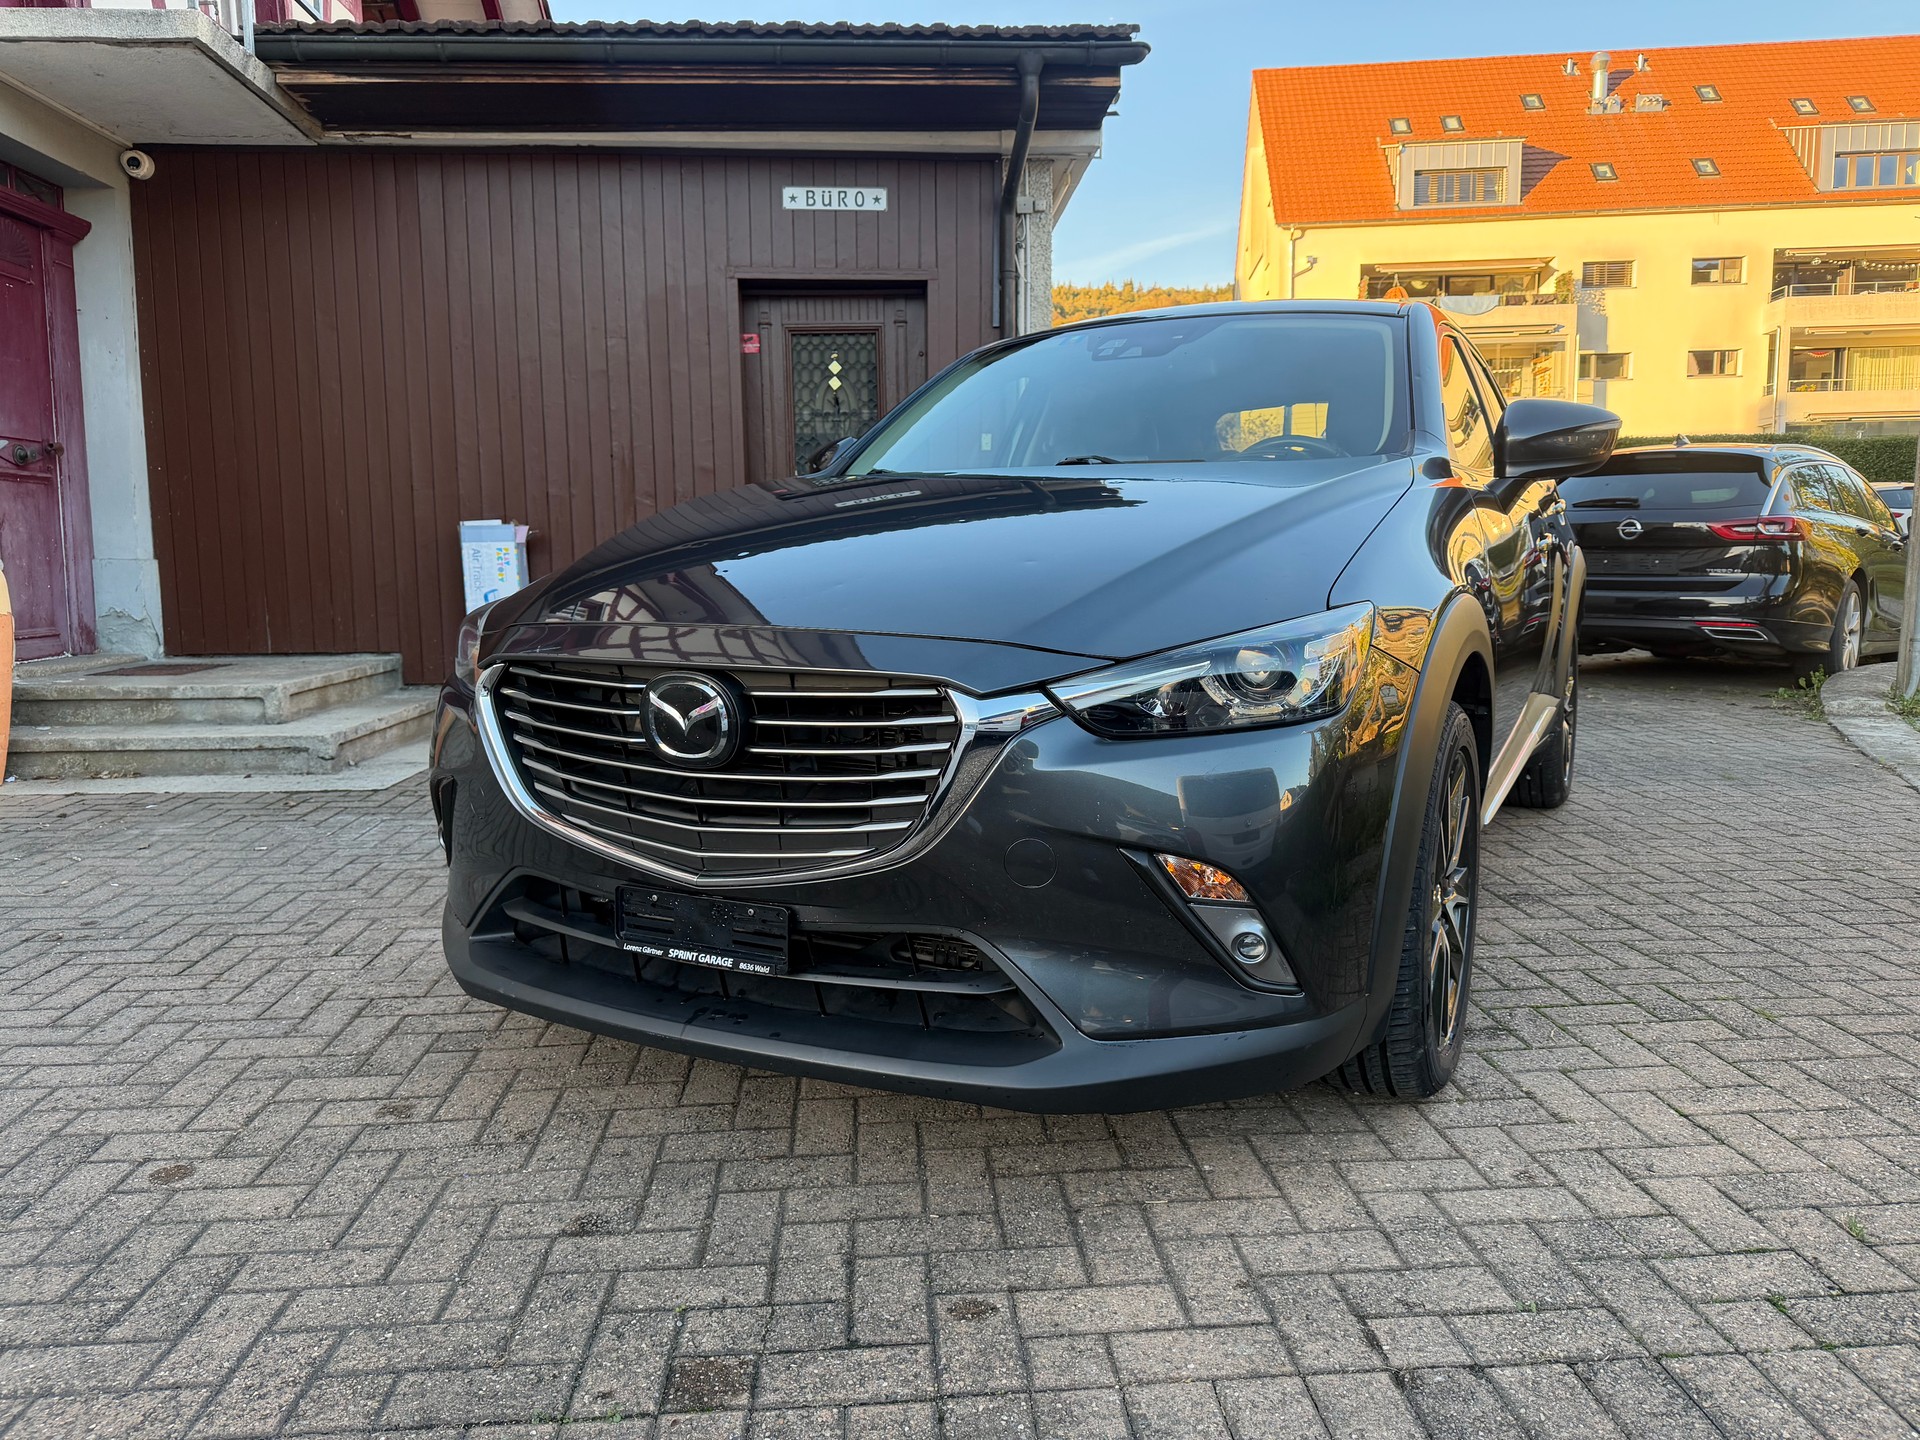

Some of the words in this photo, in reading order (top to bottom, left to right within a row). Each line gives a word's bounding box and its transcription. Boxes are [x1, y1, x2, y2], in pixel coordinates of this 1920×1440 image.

[496, 547, 505, 583] FACTORY
[503, 547, 511, 566] PLAY
[623, 943, 643, 953] Lorenz
[642, 946, 664, 956] Gärtner
[668, 948, 699, 961] SPRINT
[698, 953, 734, 968] GARAGE
[739, 962, 755, 972] 8636
[754, 964, 771, 974] Wald
